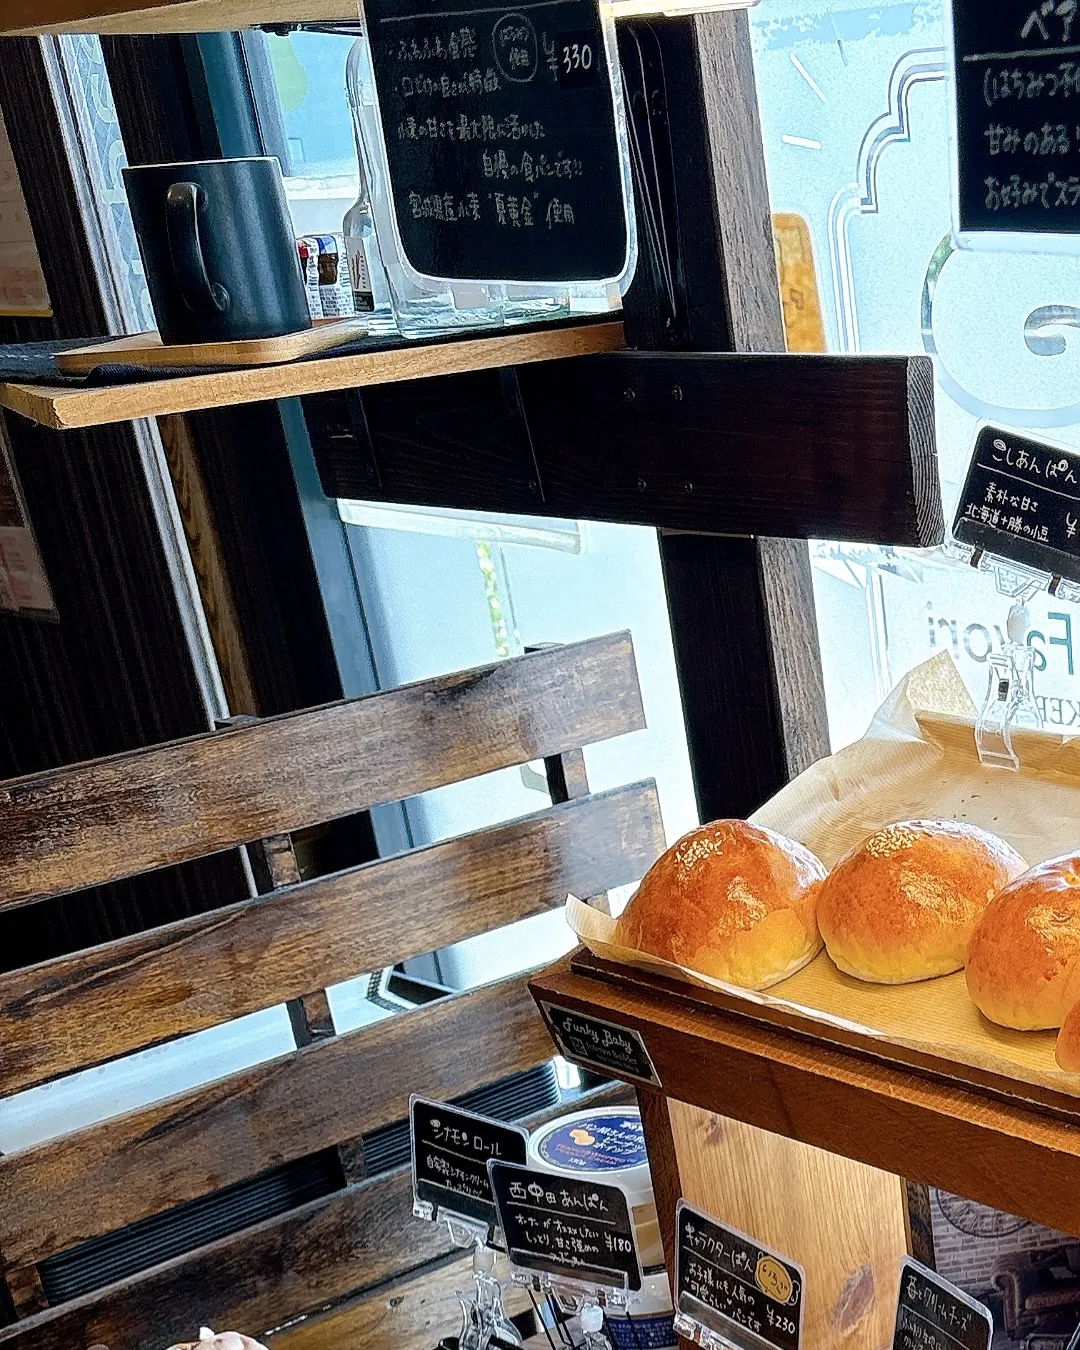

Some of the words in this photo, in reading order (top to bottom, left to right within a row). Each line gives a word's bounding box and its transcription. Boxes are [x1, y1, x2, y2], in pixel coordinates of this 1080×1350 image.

[992, 439, 1077, 484] こしあんぱん
[984, 481, 1039, 513] 素朴な甘さ
[965, 502, 1049, 543] 北海道十勝の小豆
[430, 1119, 501, 1156] シナモンロール
[604, 1231, 632, 1253] ¥180
[685, 1222, 754, 1273] キャラクターぱん
[689, 1262, 755, 1306] お子様にも人気の
[766, 1304, 796, 1334] ¥230
